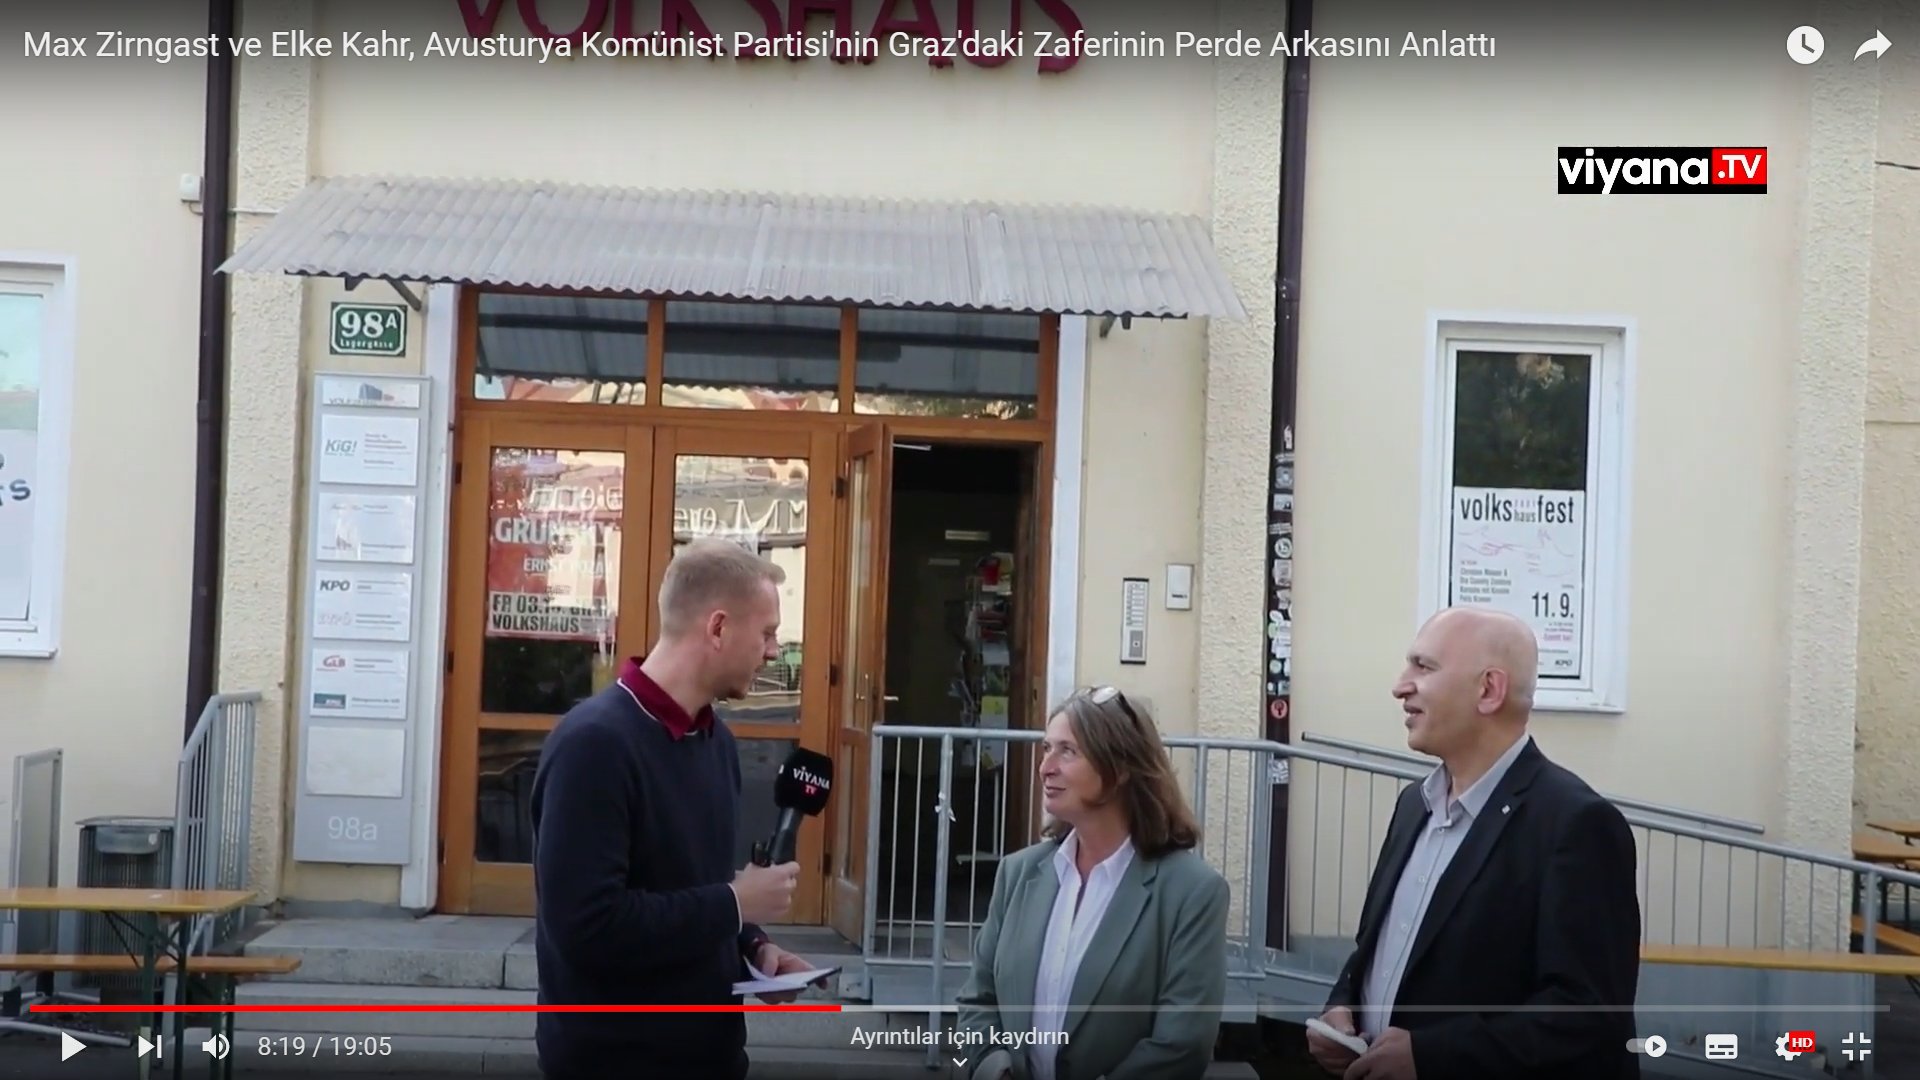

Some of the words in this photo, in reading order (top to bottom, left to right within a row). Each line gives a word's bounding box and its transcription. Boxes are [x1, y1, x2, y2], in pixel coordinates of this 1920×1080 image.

[325, 439, 357, 453] KiG!
[1461, 493, 1512, 522] volks
[1538, 495, 1574, 523] fest
[493, 614, 580, 634] VOLKSHAUS
[328, 815, 377, 841] 98a
